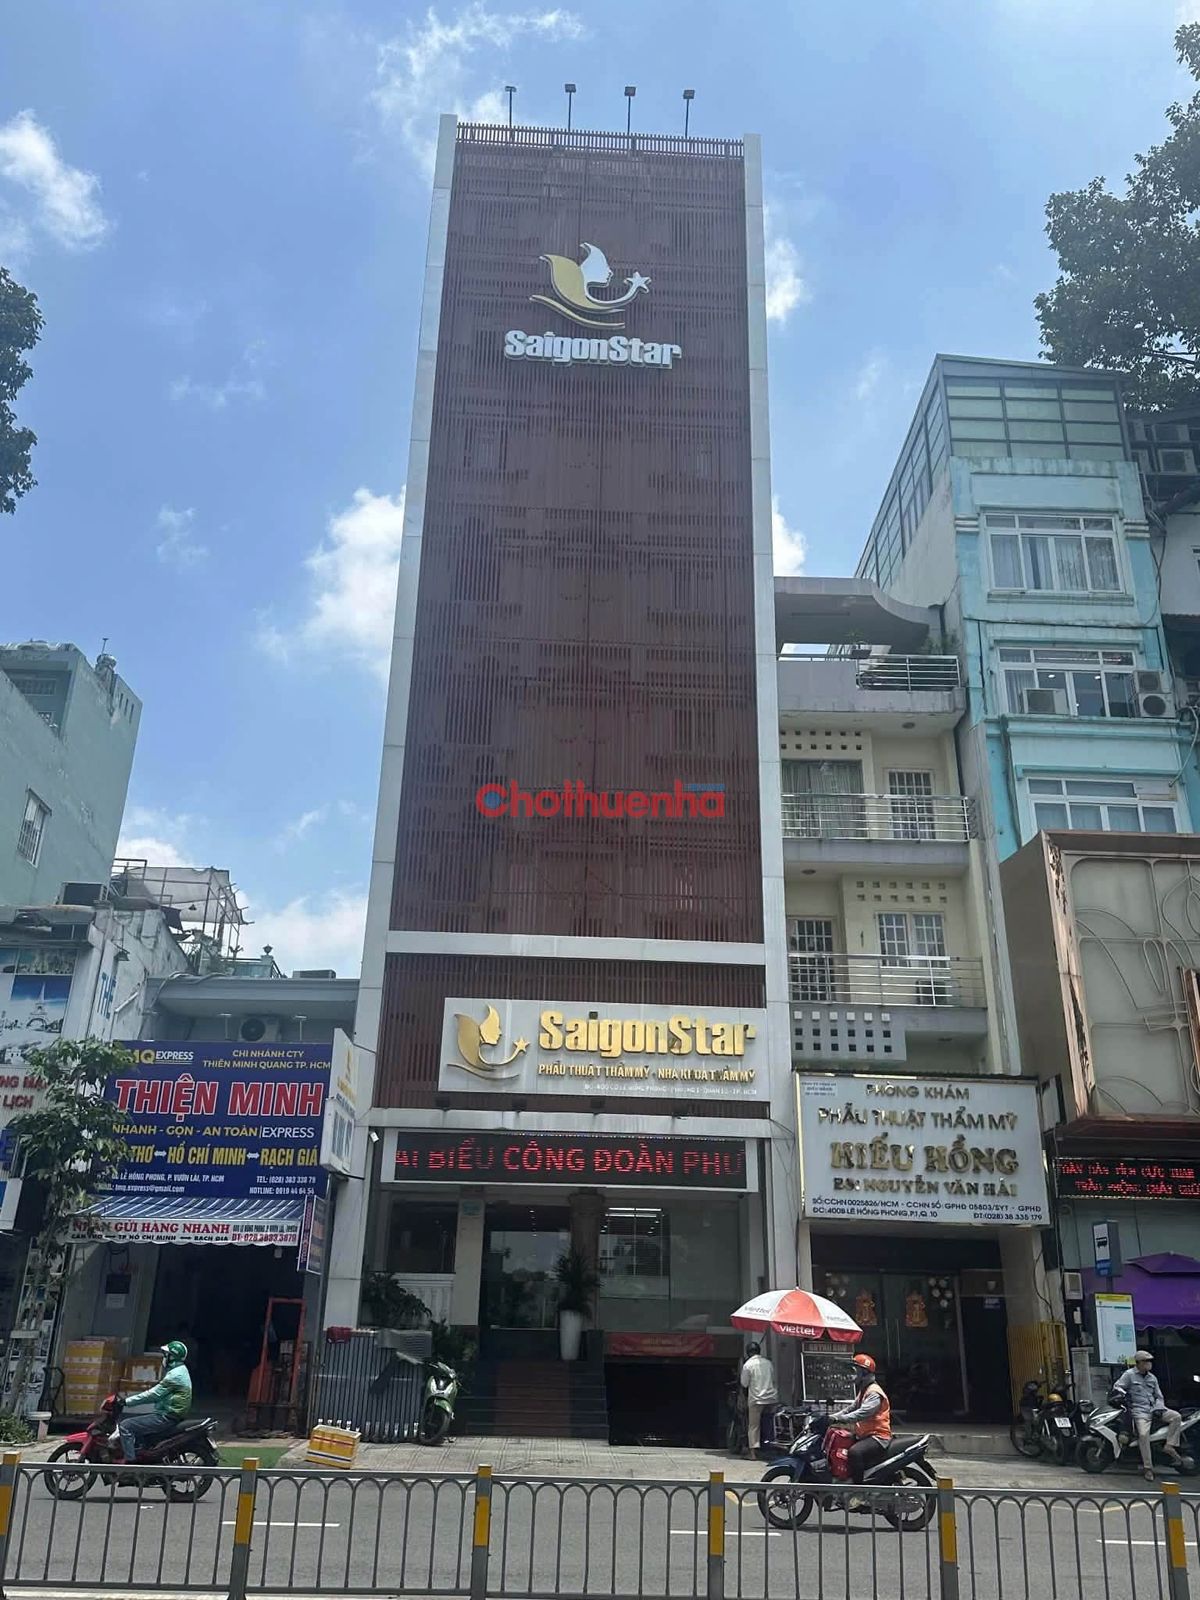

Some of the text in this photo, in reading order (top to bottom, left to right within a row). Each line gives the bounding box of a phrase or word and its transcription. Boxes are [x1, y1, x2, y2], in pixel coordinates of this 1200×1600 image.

[504, 330, 682, 369] SaigonStar
[538, 1009, 757, 1059] SaigonStar
[155, 1050, 194, 1061] EXPRESS
[233, 1049, 304, 1058] CHI NHÁNH CTY
[232, 1061, 258, 1069] MINH
[259, 1061, 293, 1070] QUANG
[295, 1061, 308, 1070] TP.
[310, 1062, 331, 1070] HCM
[658, 1068, 679, 1081] NHA
[115, 1072, 219, 1123] THIỆN
[227, 1082, 324, 1117] MINH
[866, 1081, 970, 1100] PHÒNG KHÁM
[930, 1106, 984, 1129] THẨM
[988, 1111, 1018, 1131] MỸ
[112, 1124, 315, 1139] NHANH GỌN AN TOÀN EXPRESS
[188, 1143, 209, 1165] CHÍ
[212, 1148, 247, 1166] MINH
[259, 1149, 294, 1169] RẠCH
[297, 1145, 318, 1167] GIÁ
[503, 1140, 587, 1172] CÔNG
[593, 1143, 674, 1174] ĐOÀN
[256, 1175, 269, 1183] TEL:
[863, 1175, 939, 1195] NGUYỄN
[943, 1179, 980, 1195] VĂN
[249, 1186, 275, 1195] HOTLINE:
[906, 1201, 930, 1209] CCHN
[1031, 1214, 1043, 1222] 179
[141, 1219, 179, 1233] HÀNG
[183, 1222, 231, 1234] NHANH
[779, 1325, 816, 1336] viettel
